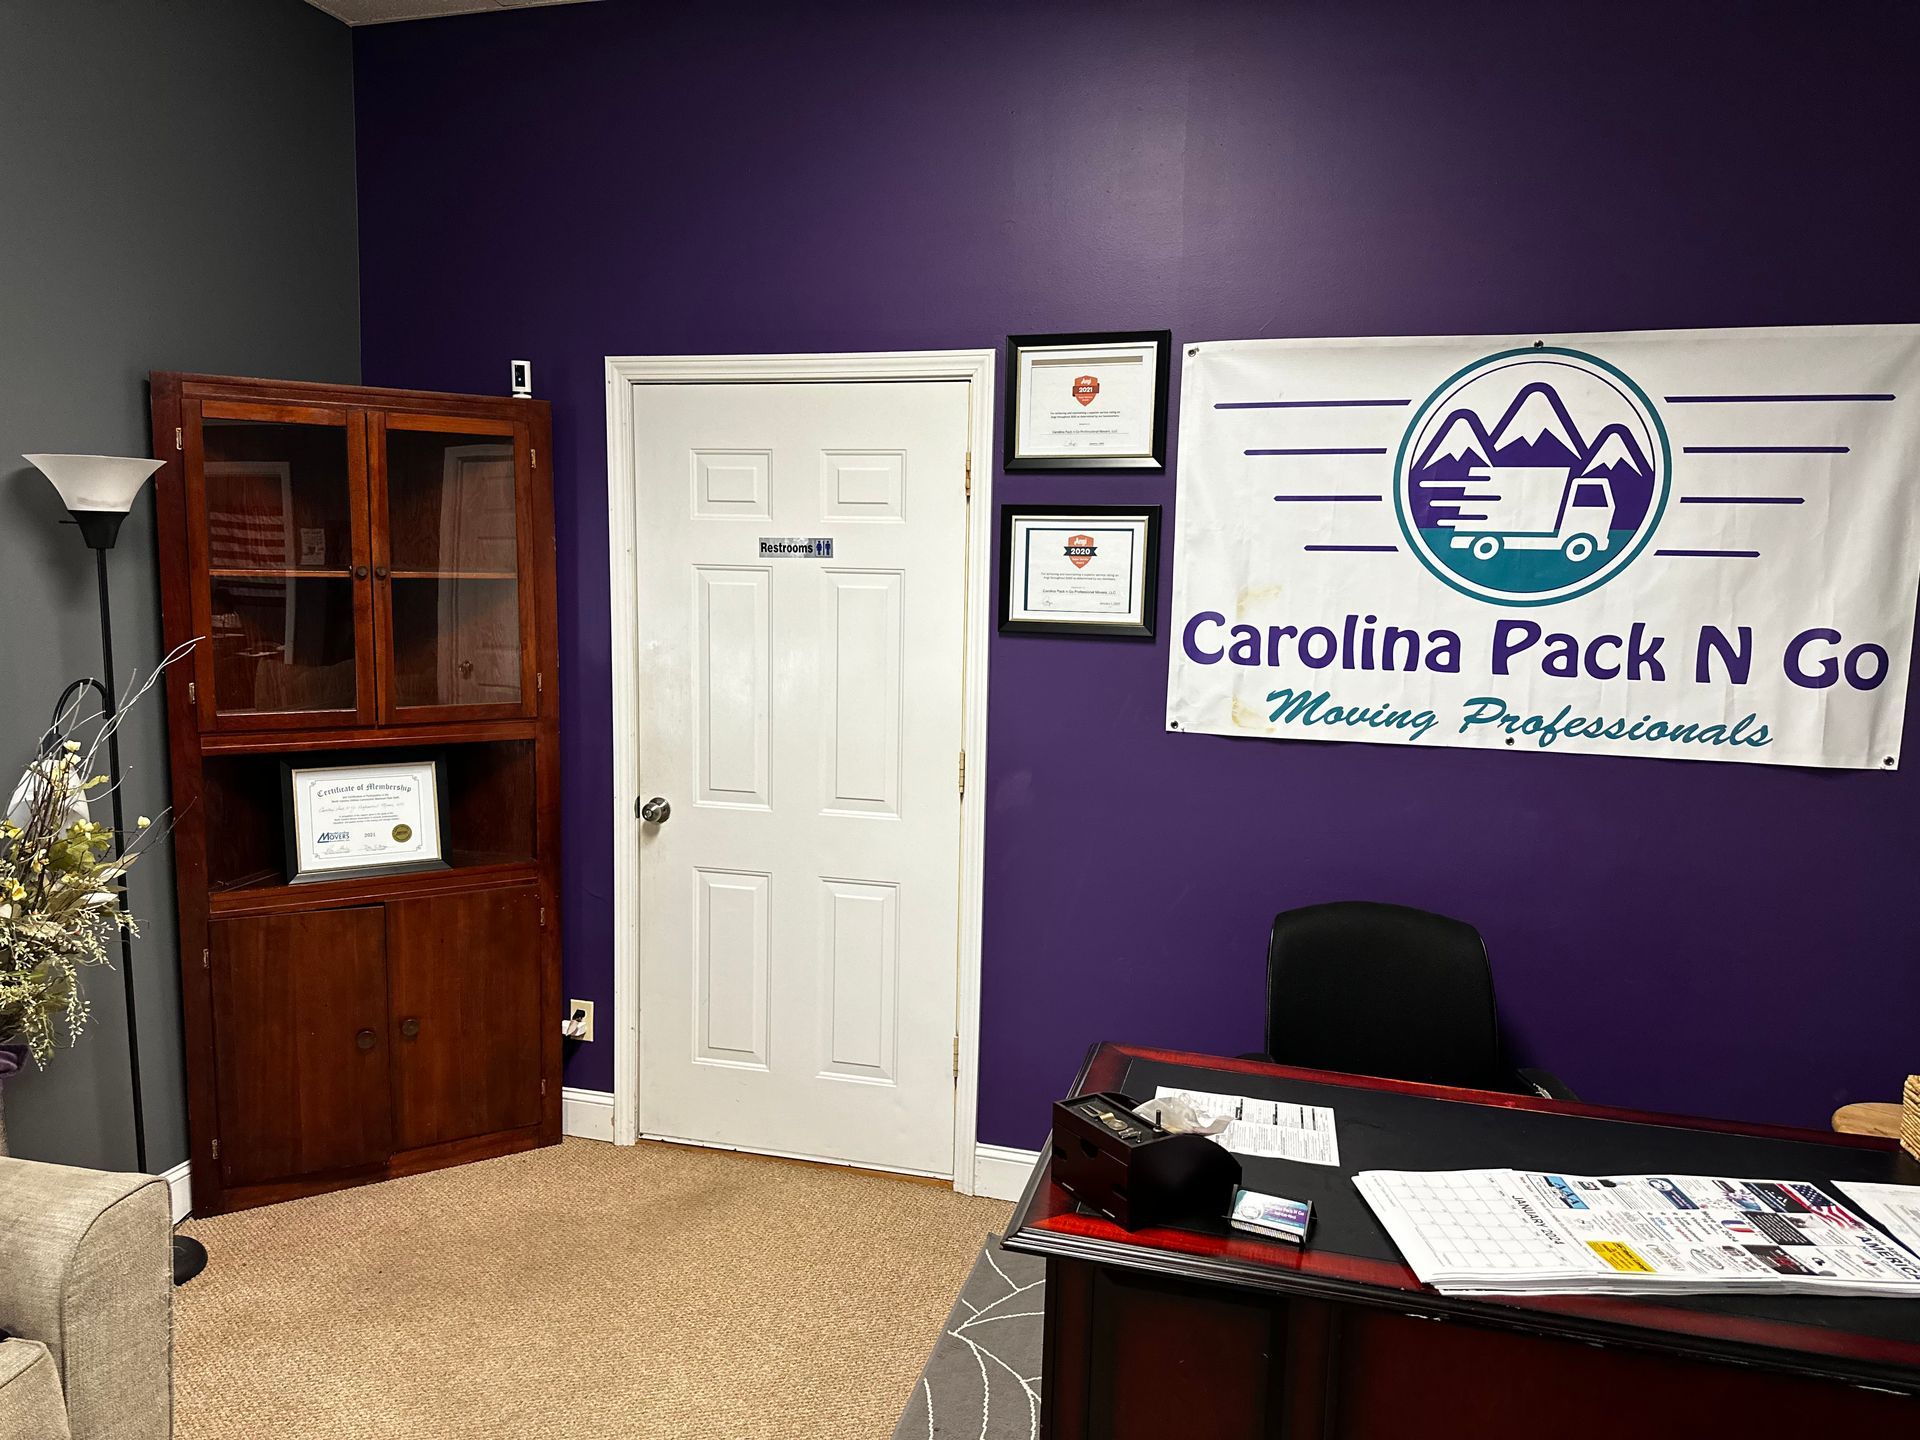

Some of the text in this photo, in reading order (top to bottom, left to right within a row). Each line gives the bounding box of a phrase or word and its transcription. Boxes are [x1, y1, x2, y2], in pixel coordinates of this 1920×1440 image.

[760, 542, 813, 553] Restrooms
[1183, 612, 1889, 690] Carolina Pack N Go
[1266, 688, 1771, 748] Moving Professionals
[317, 786, 354, 797] Certificate
[366, 782, 412, 792] Membership
[317, 832, 350, 843] MOVERS
[1554, 1182, 1580, 1205] AAA
[1512, 1195, 1548, 1228] JANUARY
[1540, 1229, 1565, 1245] 2024
